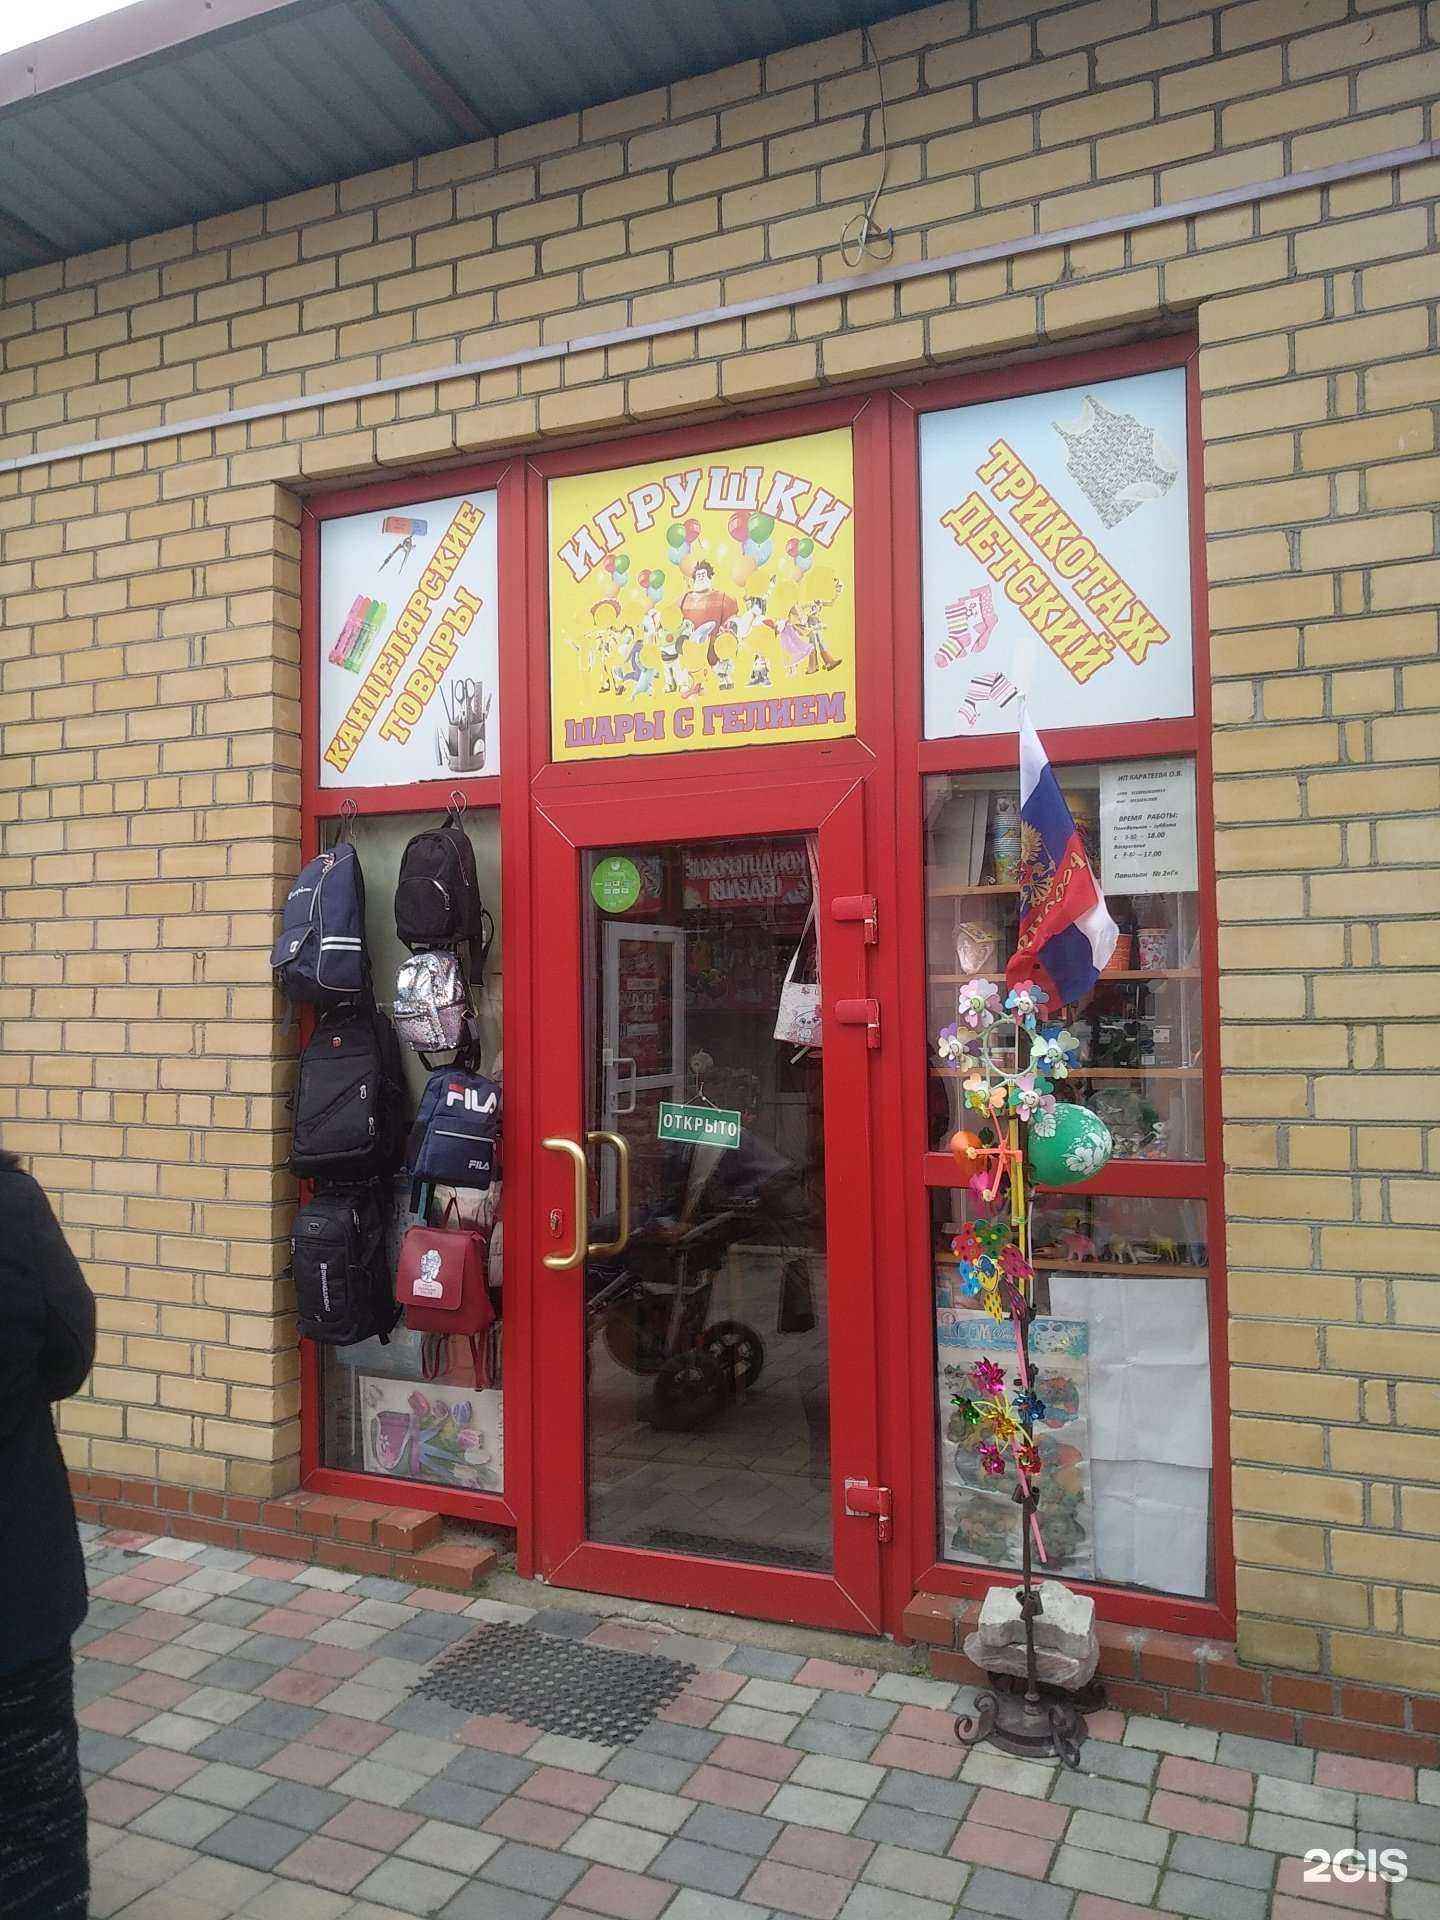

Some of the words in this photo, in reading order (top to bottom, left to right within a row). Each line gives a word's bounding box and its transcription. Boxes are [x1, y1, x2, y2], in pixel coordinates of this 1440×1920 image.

[557, 465, 852, 583] ИГРУШКИ
[975, 438, 1171, 666] ТРИКОТАЖ
[939, 491, 1118, 685] ДЕТСКИЙ
[323, 500, 486, 773] КАНЦЕЛЯРСКИЕ
[378, 585, 484, 746] ТОВАРЫ
[564, 710, 666, 748] ШАРЫ
[673, 707, 695, 738] С
[702, 691, 846, 736] ГЕЛИЕМ
[1118, 814, 1143, 822] ВРЕМЯ
[446, 1083, 498, 1114] FILA
[663, 1113, 737, 1137] ОТКРЫТО
[468, 1159, 490, 1171] FILA
